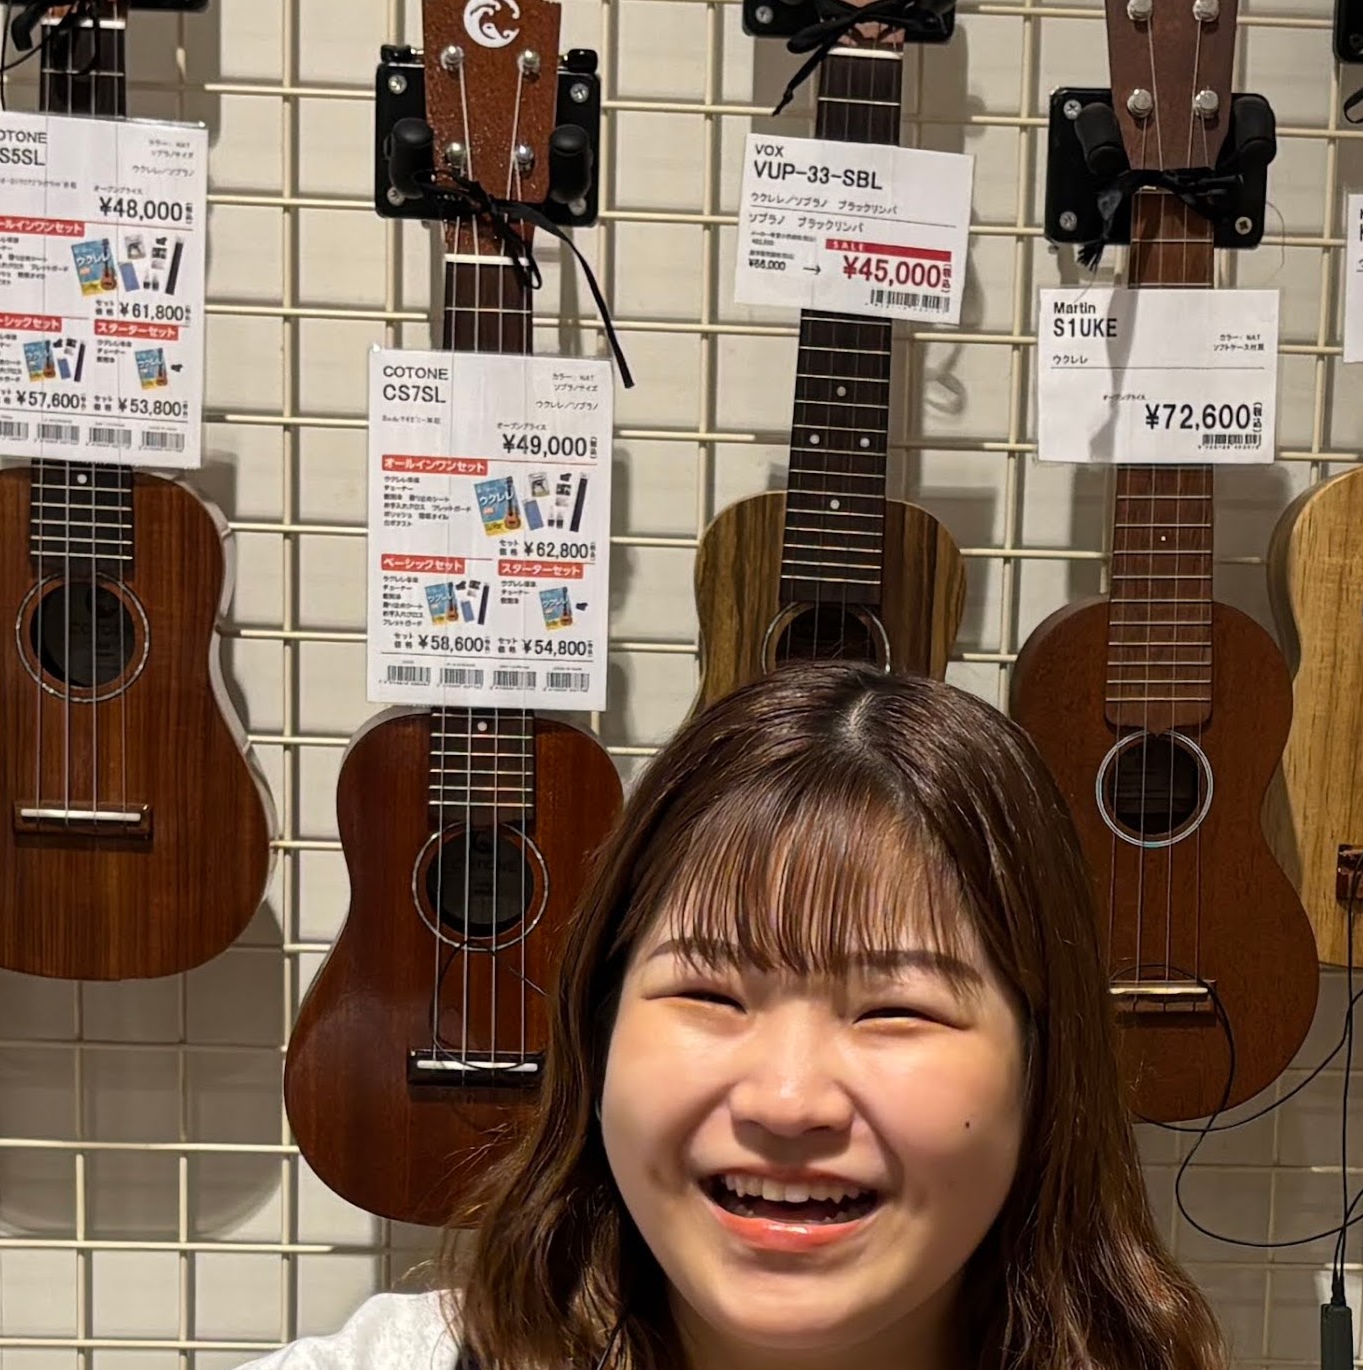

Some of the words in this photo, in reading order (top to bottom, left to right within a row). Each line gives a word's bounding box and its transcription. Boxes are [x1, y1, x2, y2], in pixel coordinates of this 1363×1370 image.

[755, 144, 784, 157] VOX
[754, 160, 883, 190] VUP-33-SBL
[99, 196, 183, 222] ¥48,000
[833, 241, 865, 251] SALE
[843, 255, 942, 288] ¥45,000
[1053, 302, 1096, 314] Martin
[1053, 318, 1118, 338] S1UKE
[383, 365, 449, 381] COTONE
[383, 384, 446, 404] CS7SL
[1145, 404, 1251, 430] ¥72,600
[503, 434, 587, 458] ¥49,000
